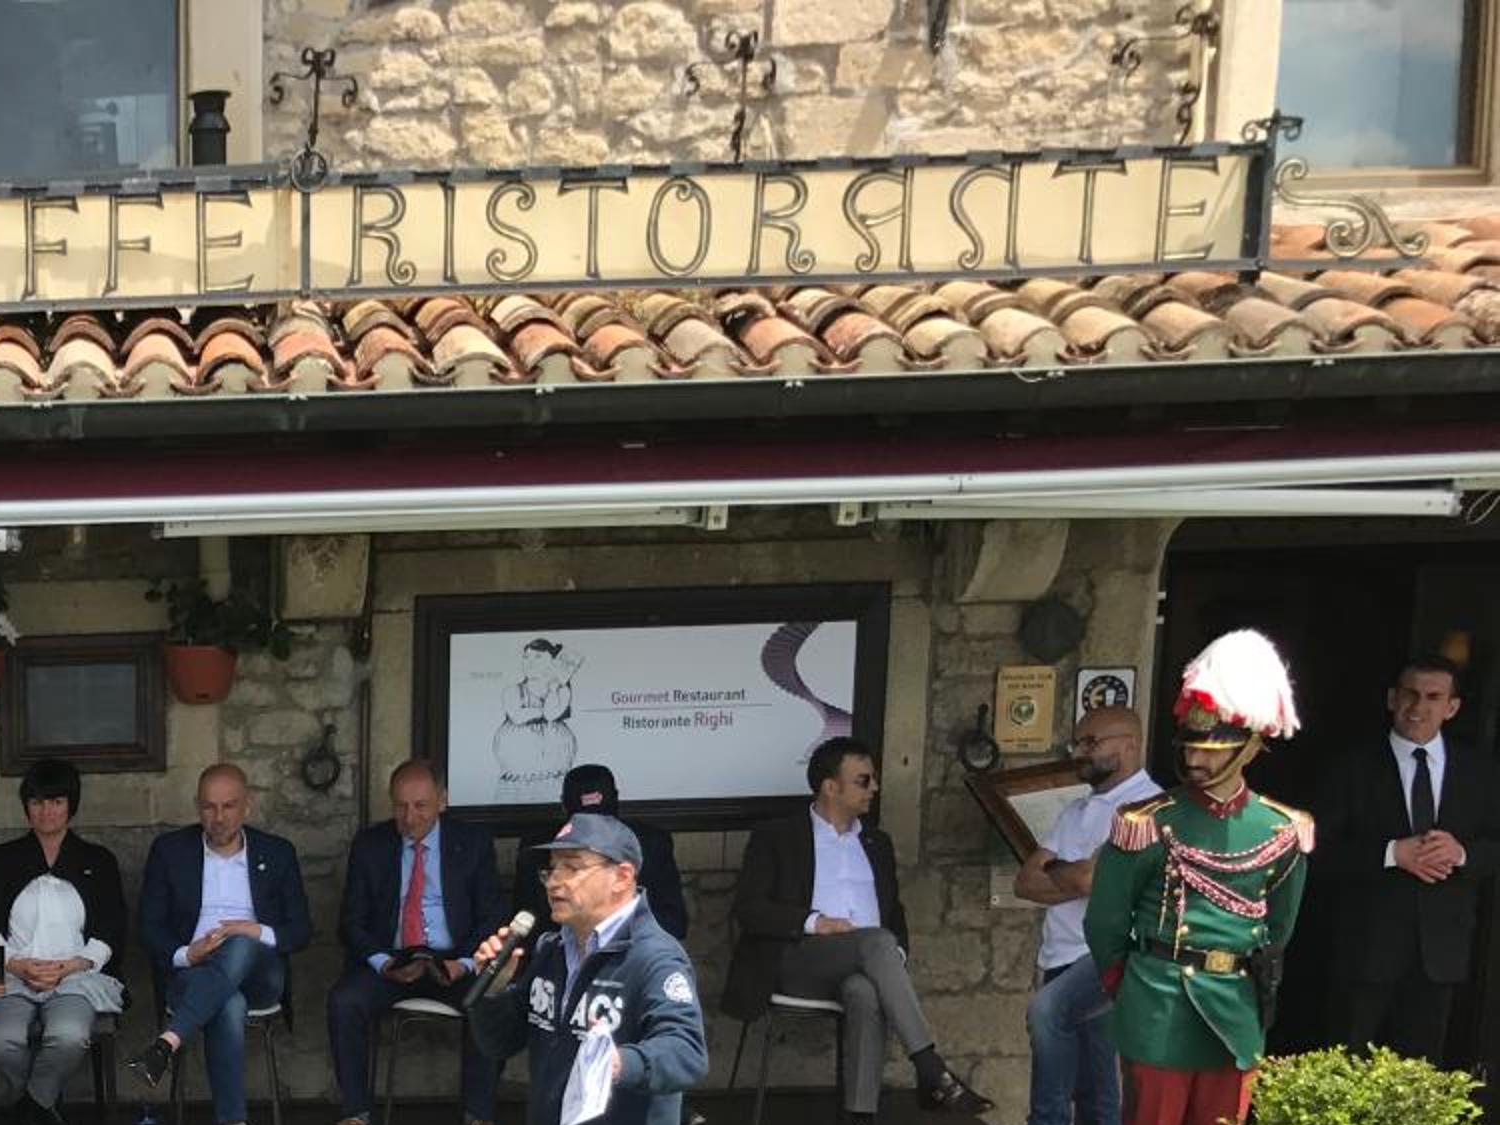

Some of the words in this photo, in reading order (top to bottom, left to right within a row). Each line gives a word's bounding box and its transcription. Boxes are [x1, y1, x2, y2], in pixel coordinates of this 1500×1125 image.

[349, 155, 1222, 286] RISTORANTE
[611, 691, 669, 704] Gourmet
[673, 688, 745, 702] Restaurant
[623, 715, 691, 729] Ristorante
[694, 710, 733, 730] Righi
